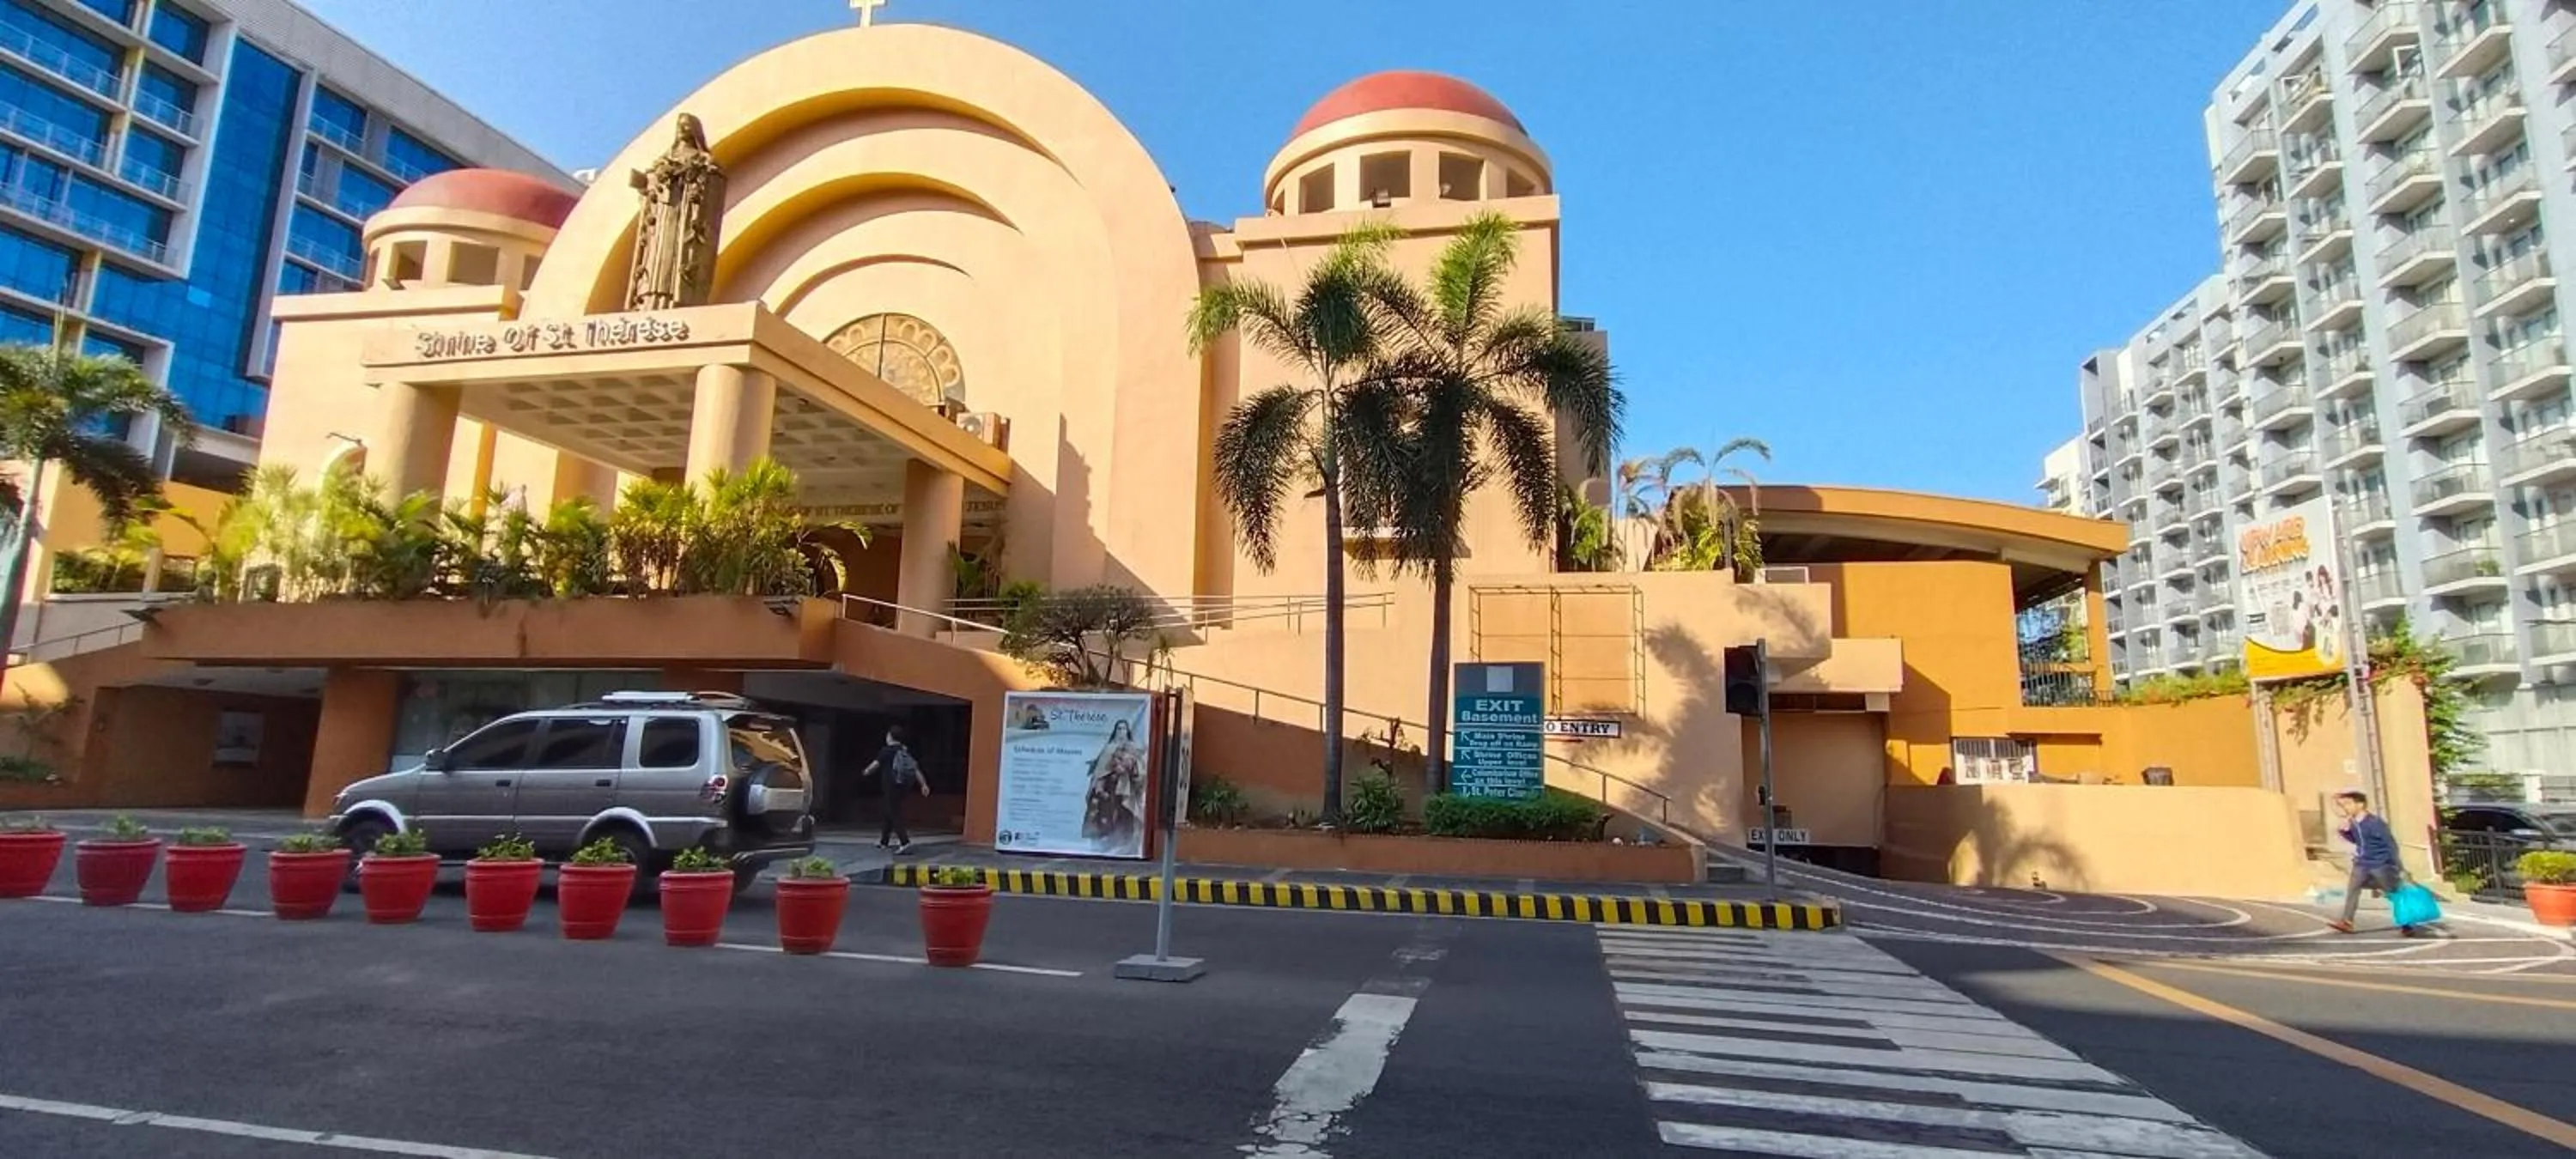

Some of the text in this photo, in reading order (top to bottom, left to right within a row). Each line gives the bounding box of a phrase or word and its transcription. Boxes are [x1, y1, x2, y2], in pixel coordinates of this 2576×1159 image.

[416, 331, 496, 358] Shrine
[504, 325, 540, 353] Of
[1475, 699, 1524, 712] EXIT
[1461, 710, 1538, 724] Basement
[1546, 722, 1610, 734] O ENTRY
[1777, 829, 1806, 842] ONLY
